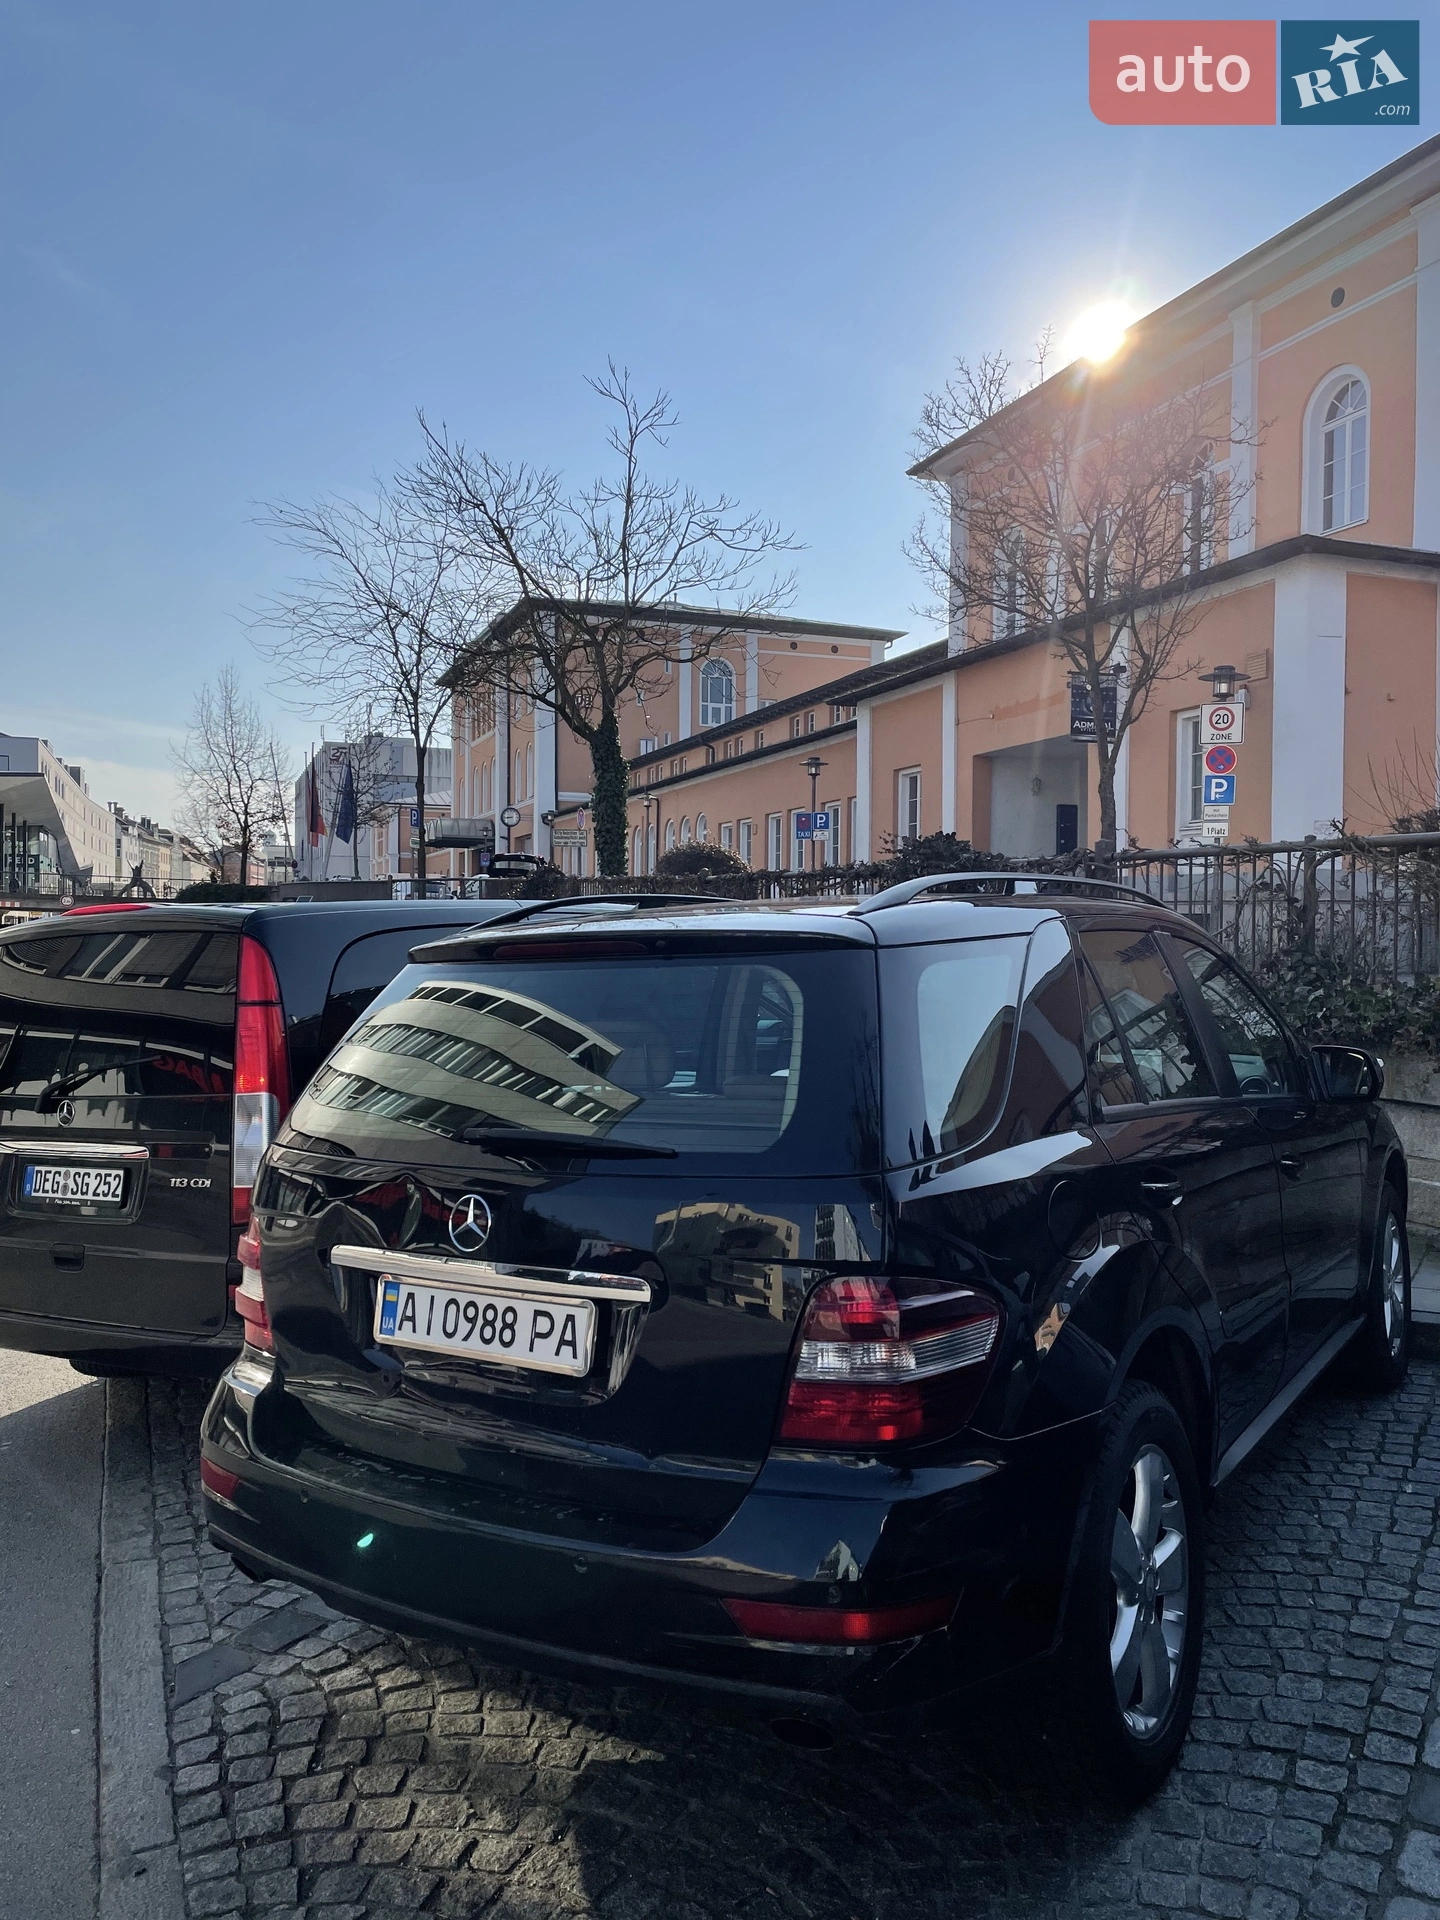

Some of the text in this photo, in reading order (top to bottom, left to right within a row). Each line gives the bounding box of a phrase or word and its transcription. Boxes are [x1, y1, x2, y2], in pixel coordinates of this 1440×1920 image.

[1214, 713, 1230, 725] 20
[1210, 732, 1233, 741] ZONE
[1211, 778, 1228, 801] P
[816, 814, 826, 828] P
[1210, 827, 1226, 835] Platz
[33, 1169, 122, 1198] DEG SG 252
[169, 1178, 188, 1188] 113
[382, 1316, 395, 1331] UA
[528, 1309, 578, 1360] PA
